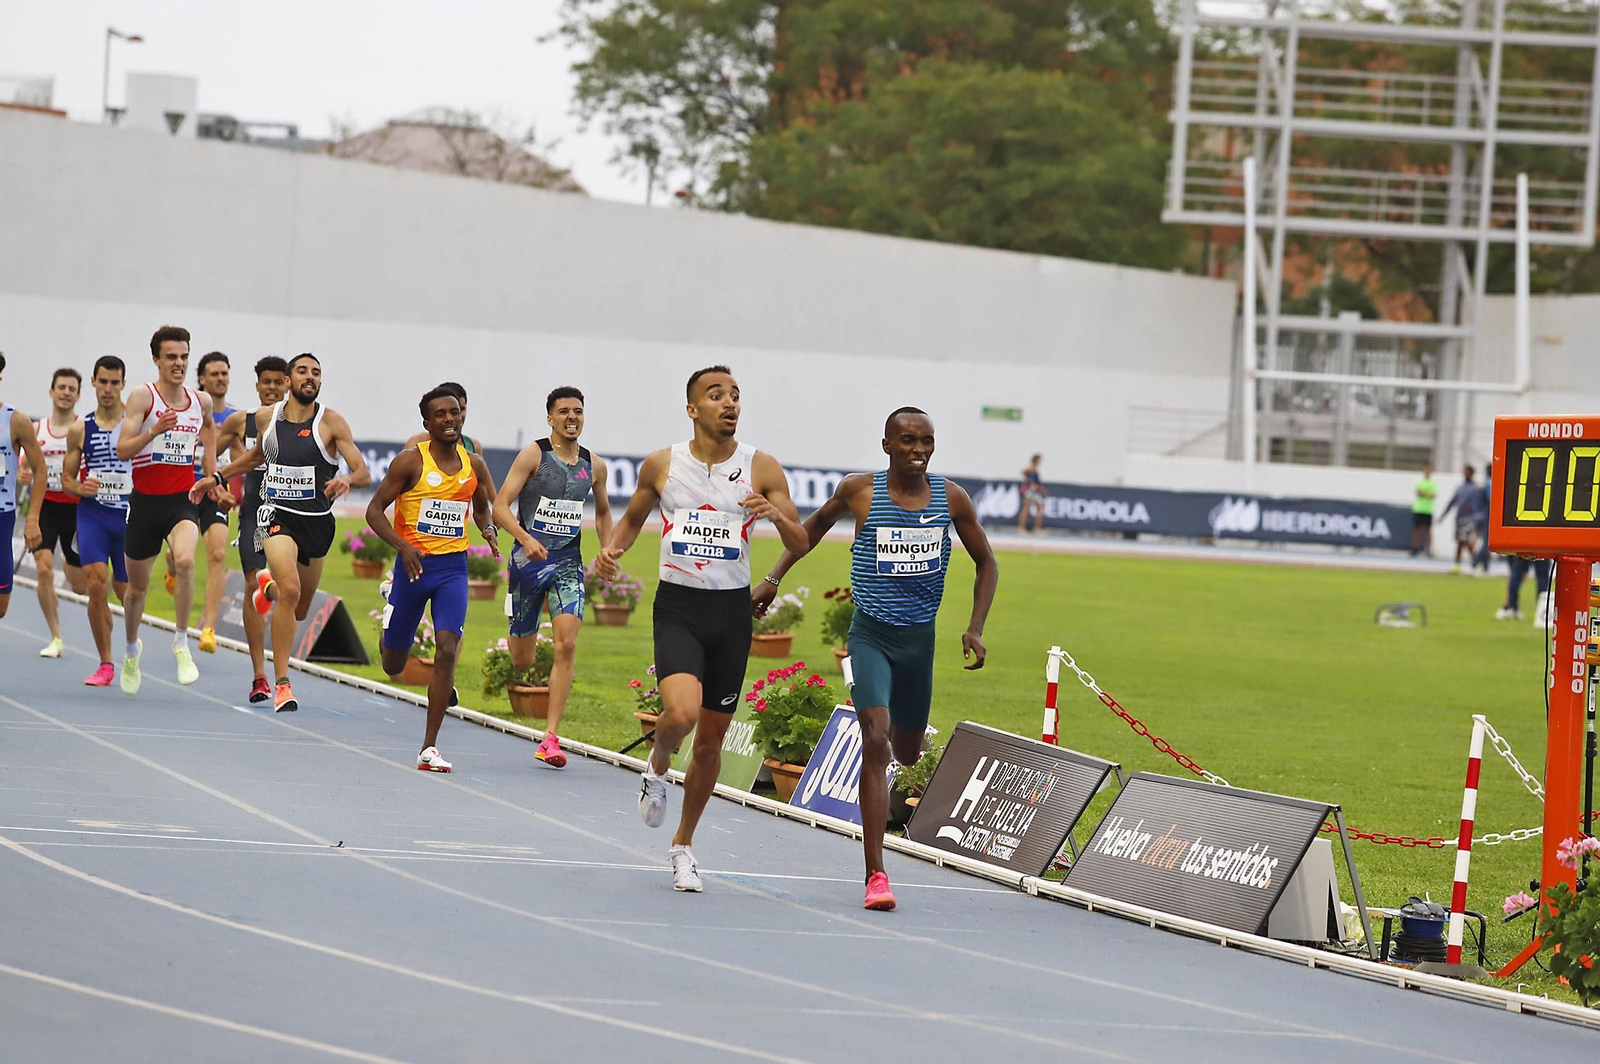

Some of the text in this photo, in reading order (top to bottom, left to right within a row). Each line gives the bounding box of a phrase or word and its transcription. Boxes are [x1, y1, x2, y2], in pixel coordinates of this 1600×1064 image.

[1528, 423, 1584, 438] MONDO
[165, 442, 186, 450] SISK
[99, 482, 124, 490] OMEZ
[1516, 447, 1600, 521] 00
[275, 489, 303, 498] Joma
[425, 510, 461, 521] GADISA
[536, 508, 582, 520] AKANKAM
[427, 525, 456, 536] Joma
[543, 523, 571, 534] Joma
[1262, 509, 1391, 540] IBERDROLA
[683, 526, 730, 539] NADER
[683, 543, 725, 558] Joma
[878, 541, 940, 554] MUNGUTI
[891, 561, 930, 574] Joma
[1571, 610, 1588, 694] MONDO
[801, 716, 863, 806] Jom
[972, 795, 1038, 837] DE HUELVA
[1093, 815, 1153, 861] Huelva
[1180, 836, 1215, 875] tus
